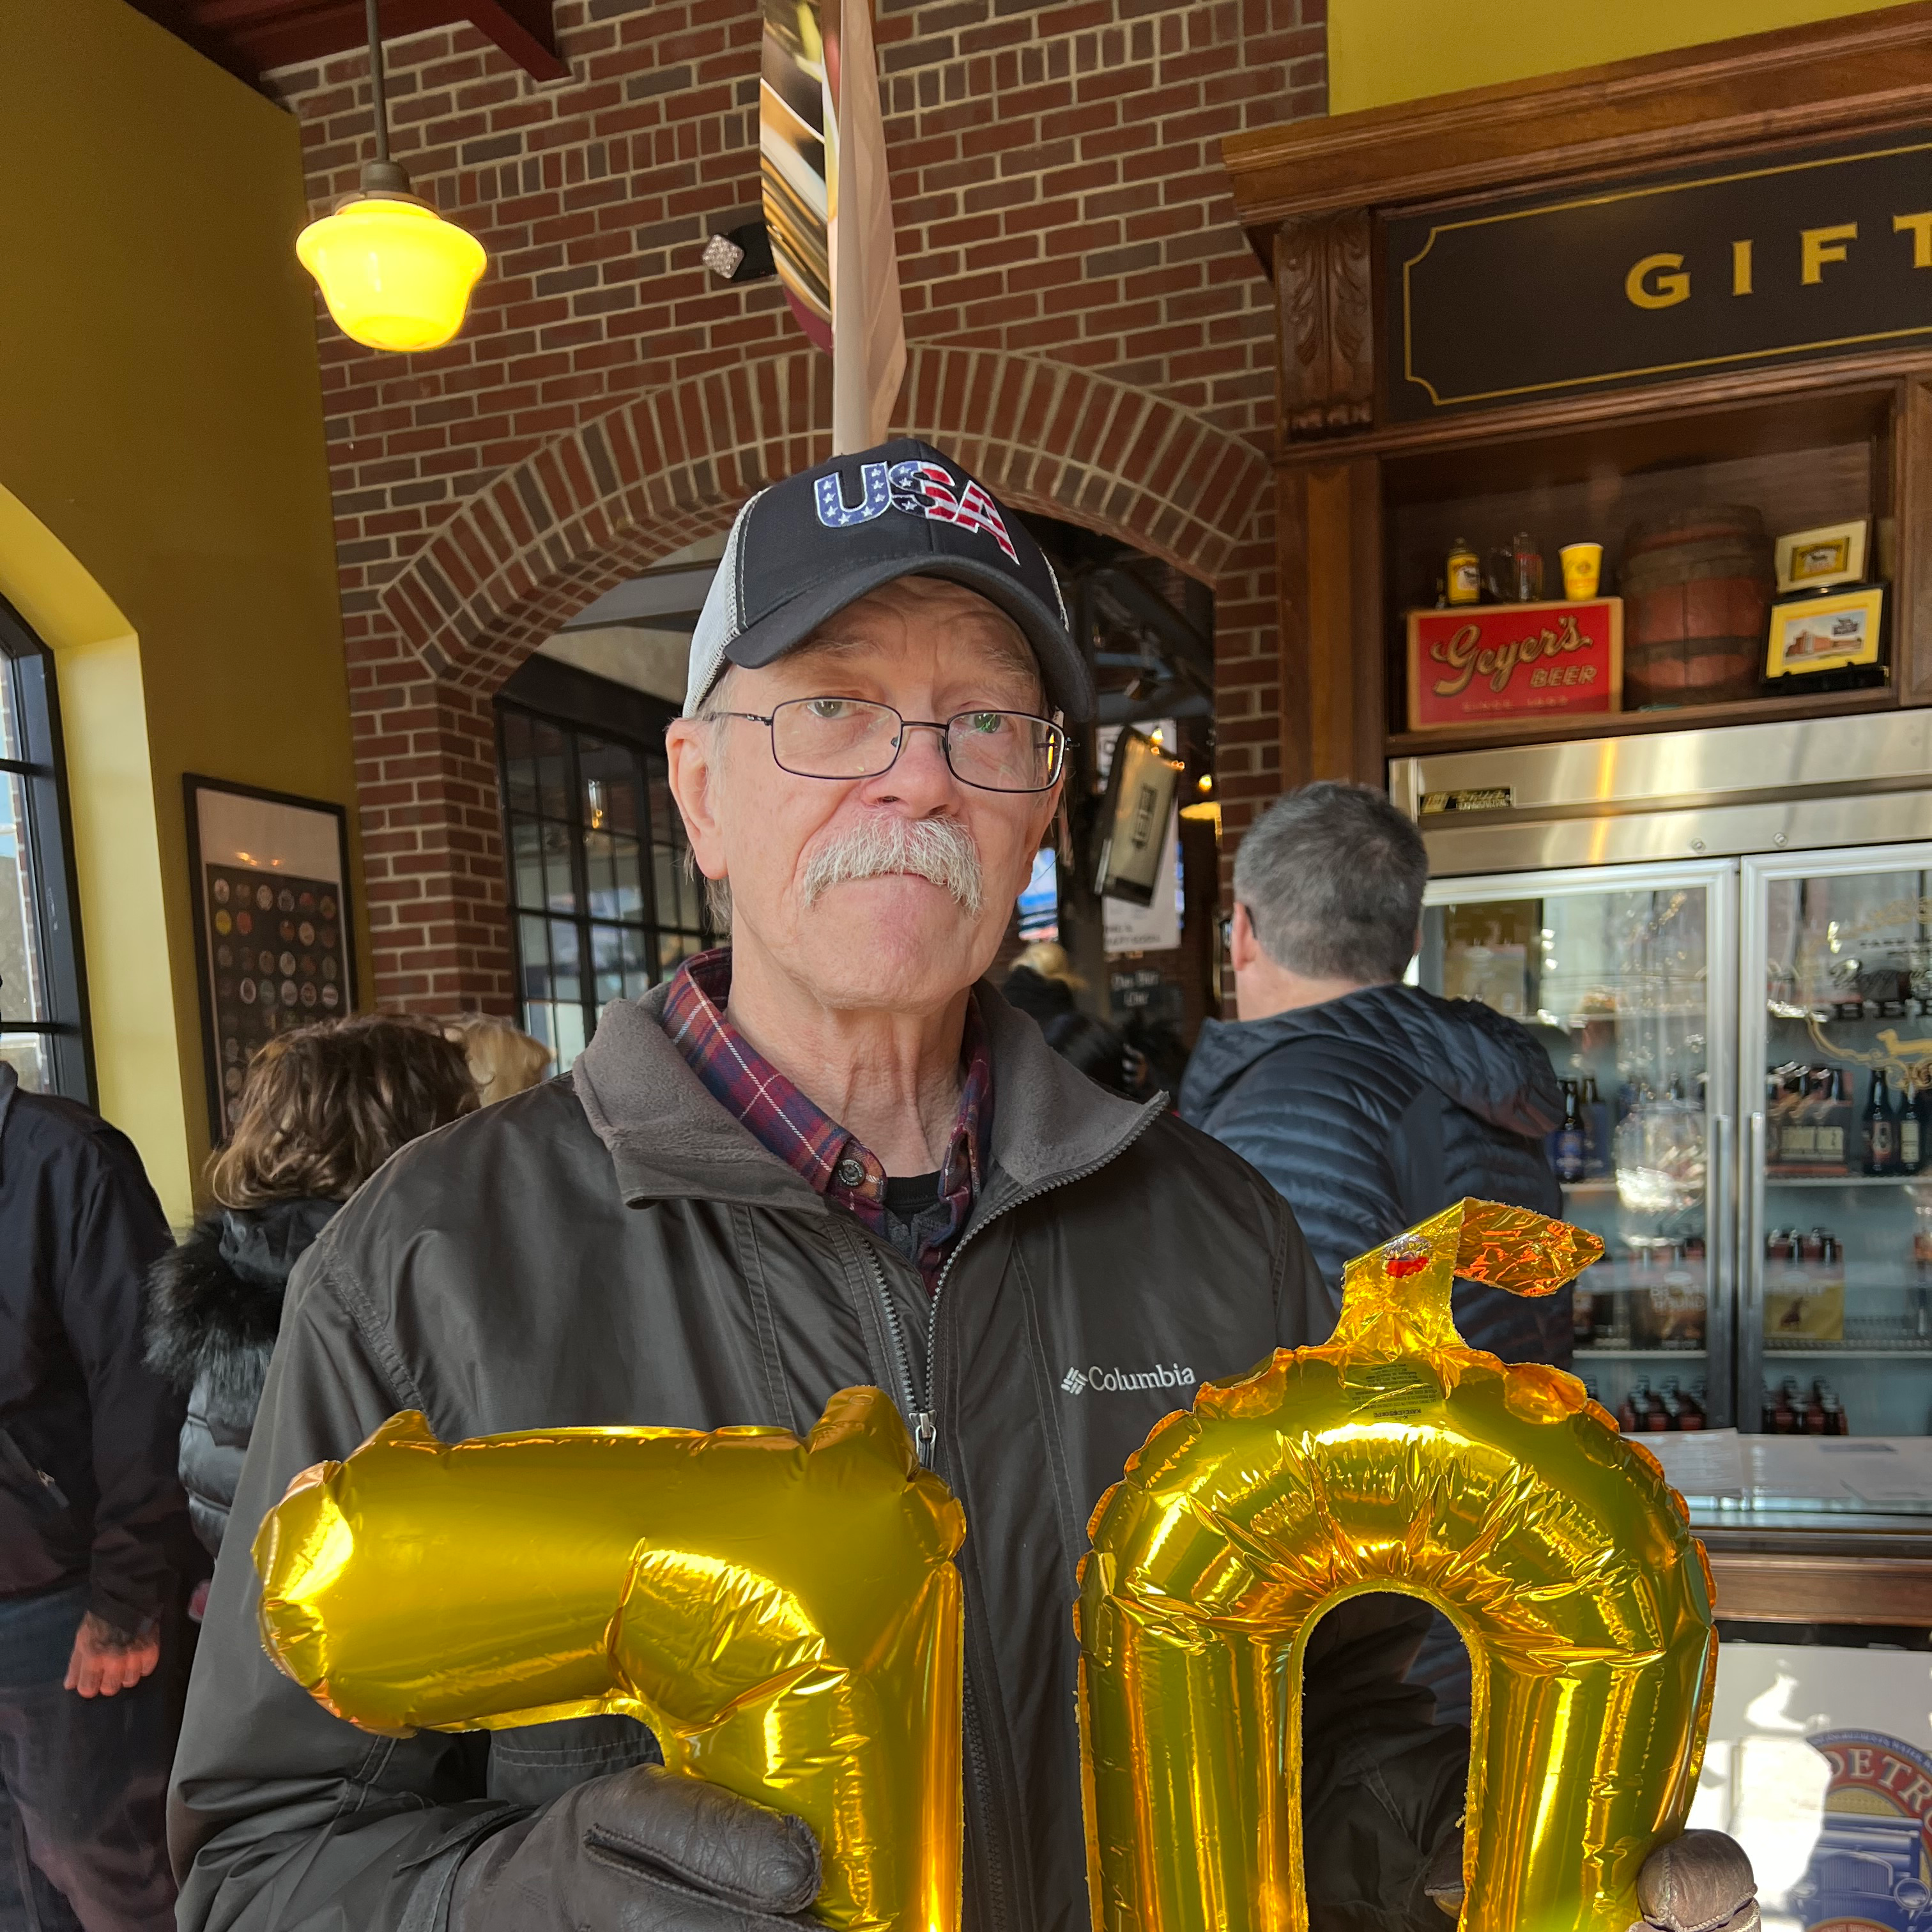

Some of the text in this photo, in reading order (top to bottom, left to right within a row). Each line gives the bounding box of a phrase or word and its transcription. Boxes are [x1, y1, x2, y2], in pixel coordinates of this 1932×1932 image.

[813, 460, 1021, 565] USA
[1431, 616, 1593, 696] Geyer's
[1530, 664, 1598, 688] BEER
[1088, 1362, 1196, 1392] Columbia
